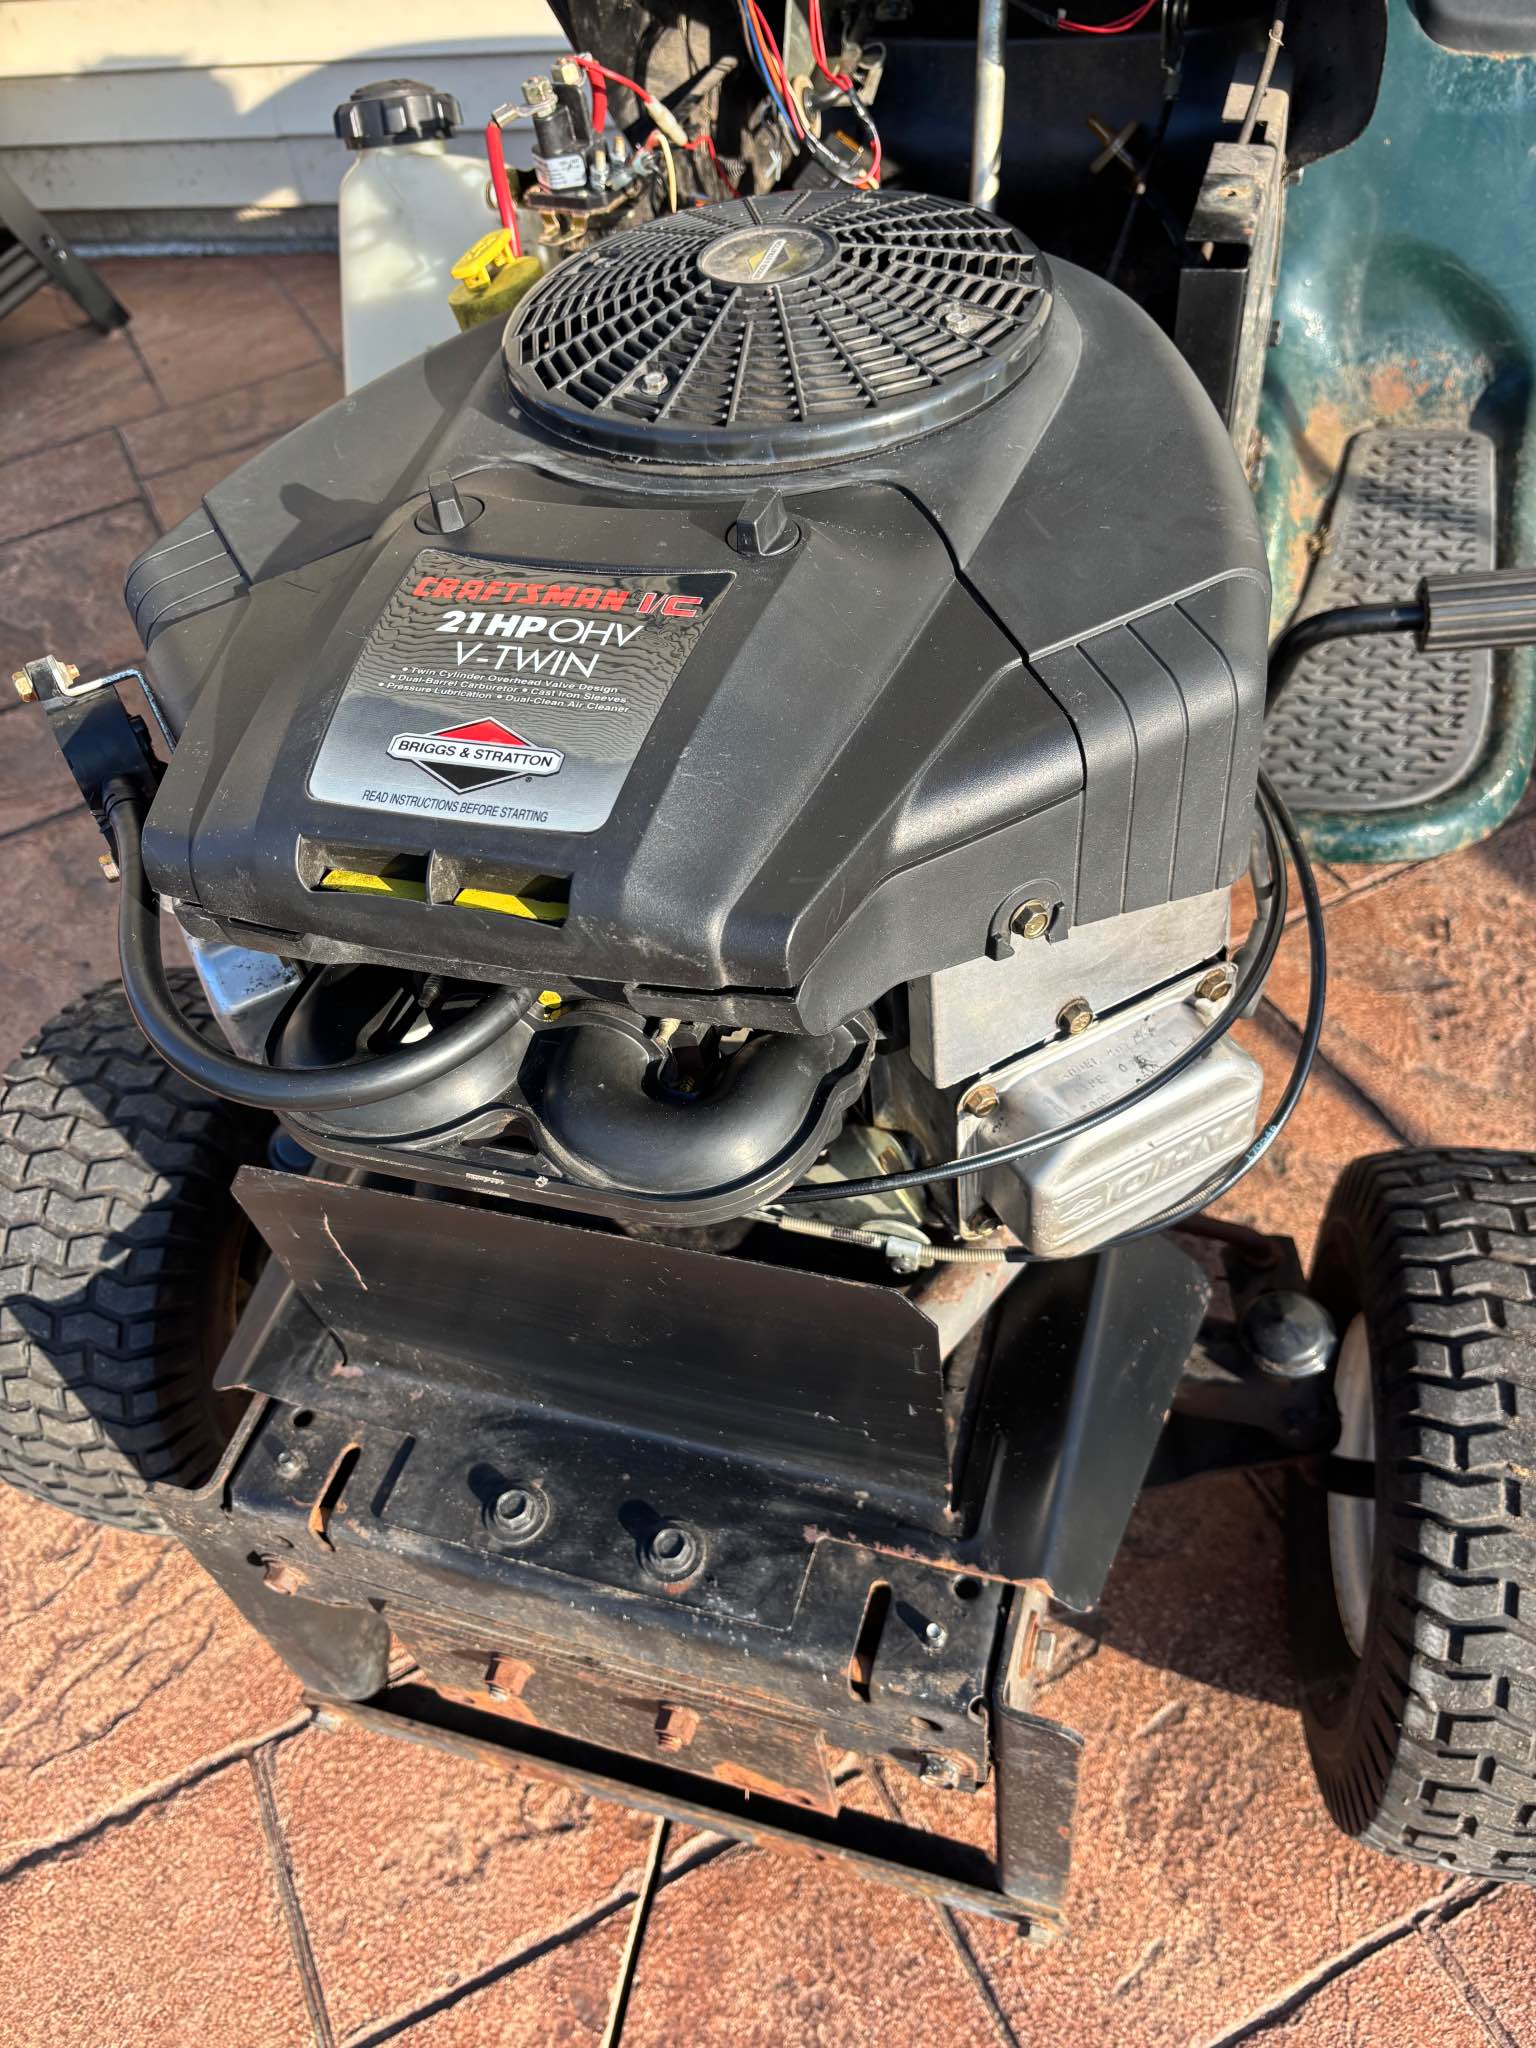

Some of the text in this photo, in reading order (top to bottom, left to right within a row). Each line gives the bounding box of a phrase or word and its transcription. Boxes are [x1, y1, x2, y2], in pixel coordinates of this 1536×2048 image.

[412, 576, 630, 612] CRAFTSMAN
[548, 618, 646, 648] OHV
[456, 641, 600, 679] V-TWIN
[398, 674, 627, 704] Dual-Barrel Carburetor Cast Iron Sleeves
[411, 666, 618, 694] Twin Cylinder Overhead Valve Design
[386, 682, 630, 713] Pressure Lubrication Dual-Clean Air Cleaner
[399, 740, 555, 767] BRIGGS & STRATTON
[362, 789, 549, 823] READ INSTRUCTIONS BEFORE STARTING
